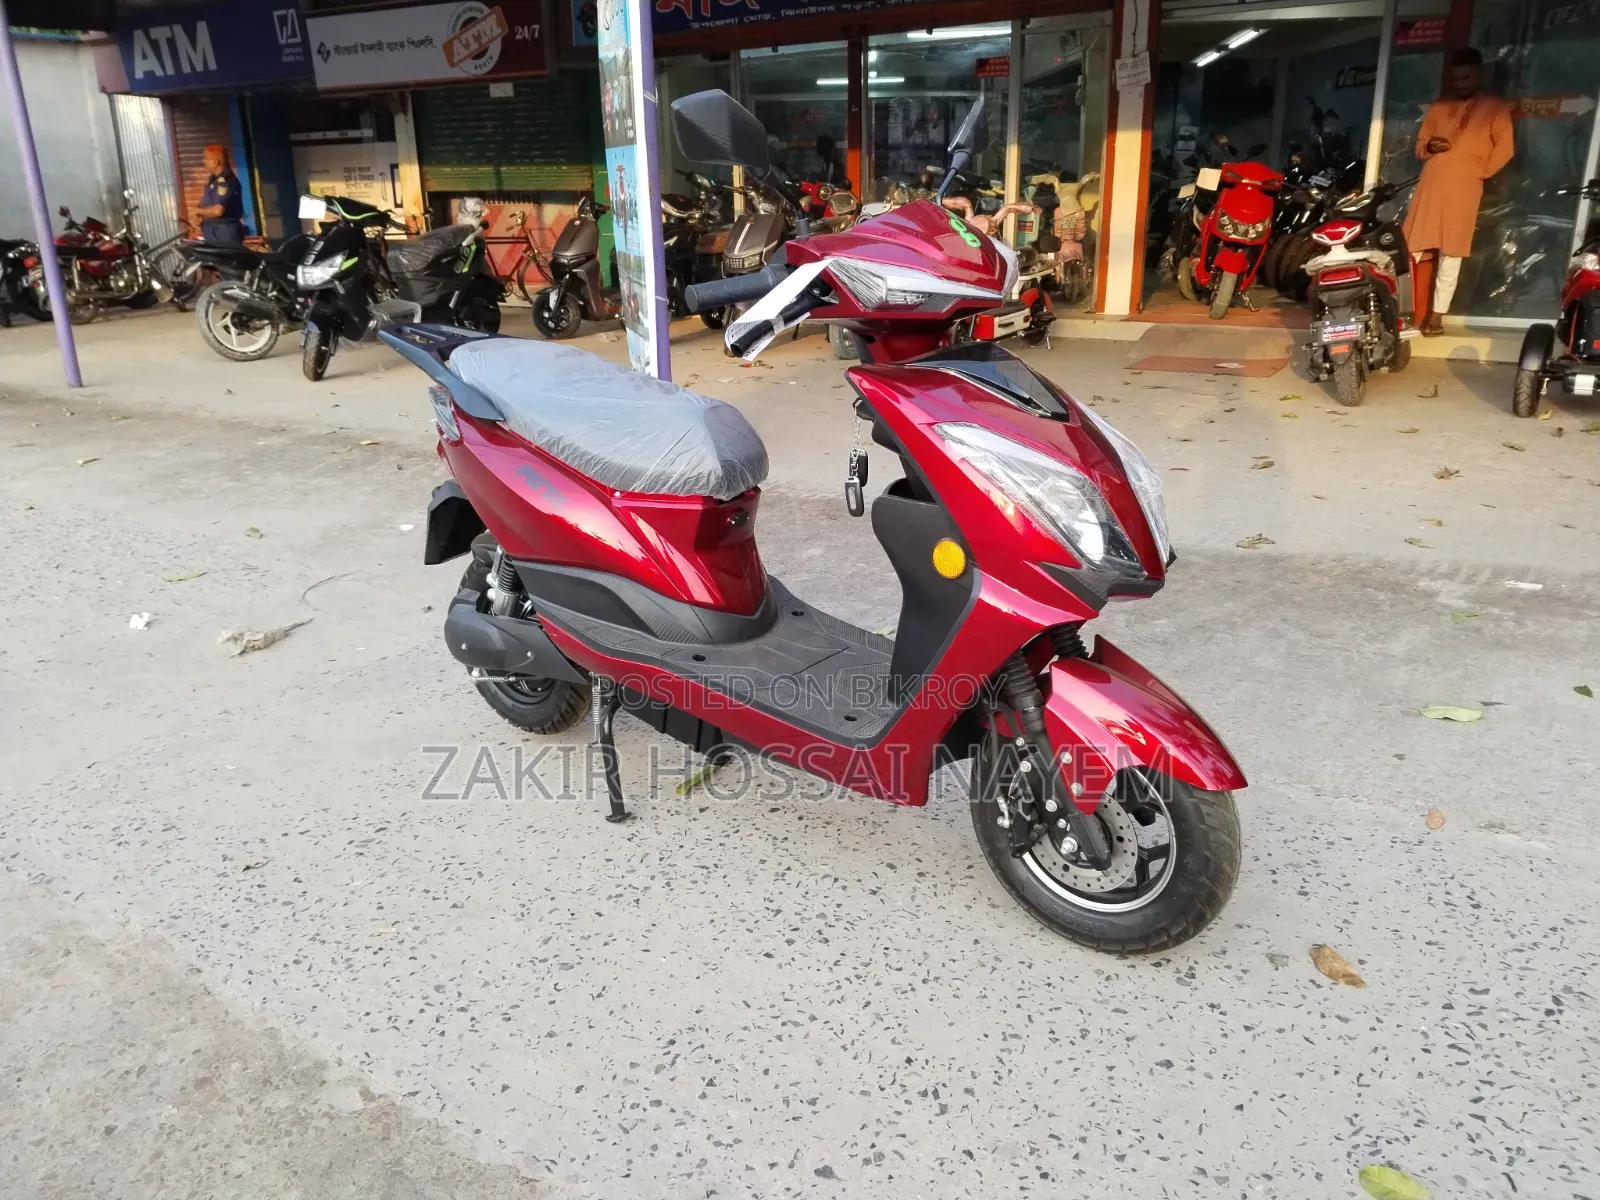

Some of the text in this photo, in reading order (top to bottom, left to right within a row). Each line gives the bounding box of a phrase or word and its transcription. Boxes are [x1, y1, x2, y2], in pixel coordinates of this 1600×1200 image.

[690, 17, 738, 29] উপজেলা
[780, 4, 836, 17] ঝিনাইদহ
[452, 13, 502, 65] ATM
[514, 24, 540, 41] 24/7
[132, 20, 218, 79] ATM
[360, 40, 384, 55] ইসলামী
[386, 40, 406, 53] ব্যাংক
